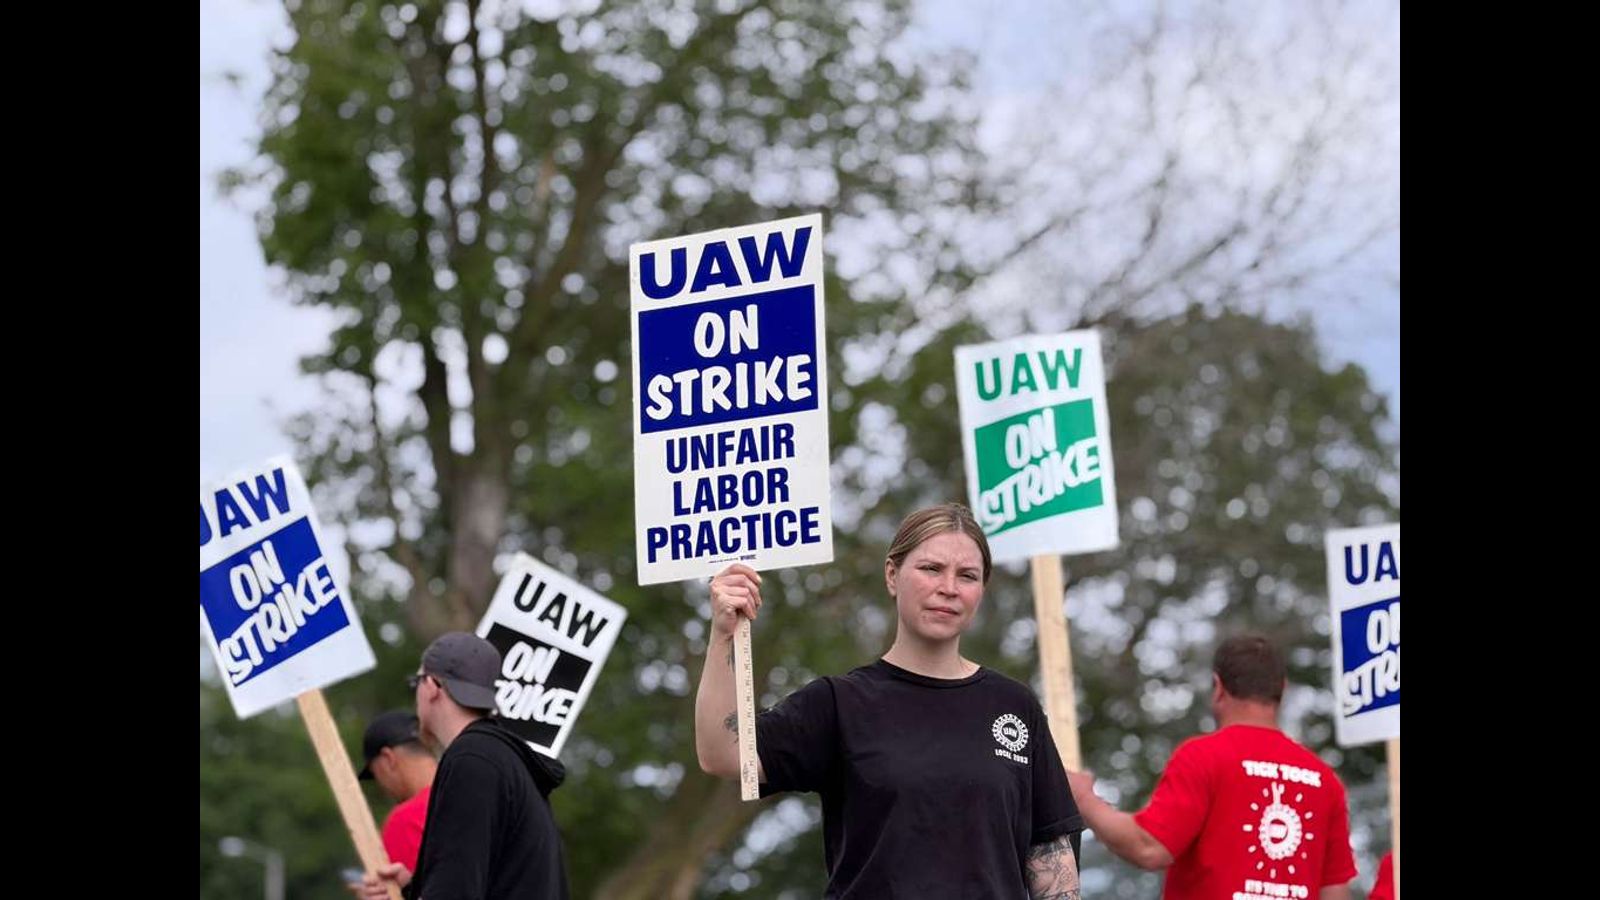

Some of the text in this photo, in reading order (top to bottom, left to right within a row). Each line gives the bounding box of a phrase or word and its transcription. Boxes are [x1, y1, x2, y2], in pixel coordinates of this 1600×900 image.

[640, 226, 812, 300] UAW
[694, 304, 759, 358] ON
[646, 354, 812, 421] STRIKE
[974, 348, 1082, 401] UAW
[666, 423, 795, 474] UNFAIR
[1005, 407, 1058, 469] ON
[673, 467, 790, 517] LABOR
[979, 436, 1102, 534] STRIKE
[647, 507, 821, 563] PRACTICE
[230, 540, 286, 612] ON
[1344, 541, 1400, 586] UA
[219, 556, 339, 686] STRIKE
[513, 573, 609, 648] UAW
[502, 640, 560, 684] ON
[1343, 646, 1400, 716] STR
[494, 679, 575, 726] RIKE
[1242, 760, 1321, 788] TICK TOCK
